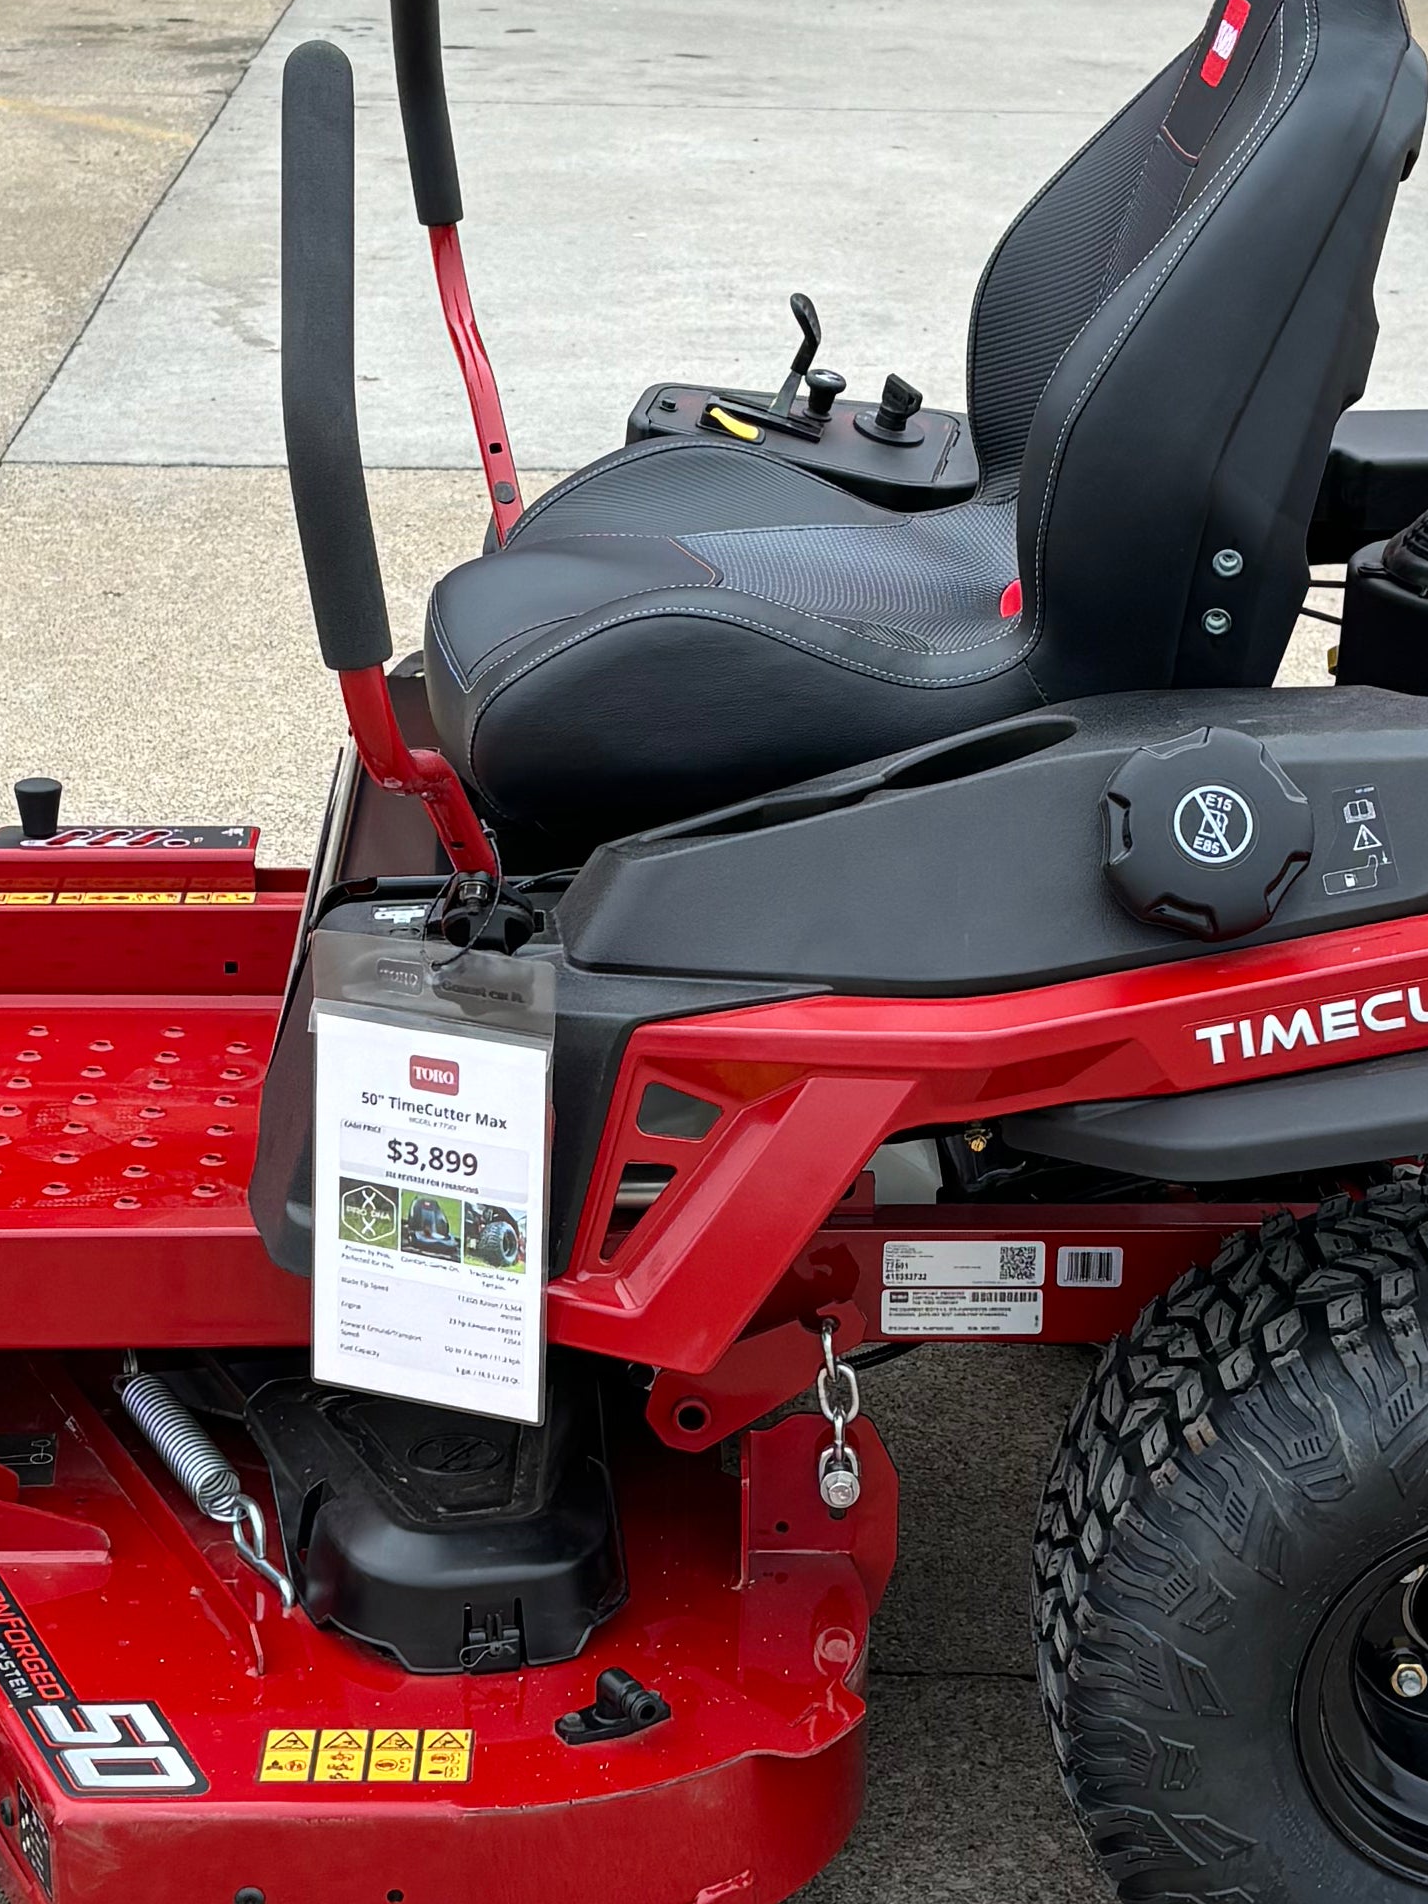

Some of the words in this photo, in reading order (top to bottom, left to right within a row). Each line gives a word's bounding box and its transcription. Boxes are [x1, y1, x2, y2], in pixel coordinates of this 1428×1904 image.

[1204, 792, 1233, 812] E15
[1193, 835, 1221, 855] E85
[412, 1065, 455, 1085] TORO
[361, 1091, 384, 1105] 50"
[388, 1096, 471, 1123] TimeCutter
[475, 1112, 507, 1130] Max
[387, 1137, 478, 1176] $3,899
[28, 1703, 197, 1791] 50
